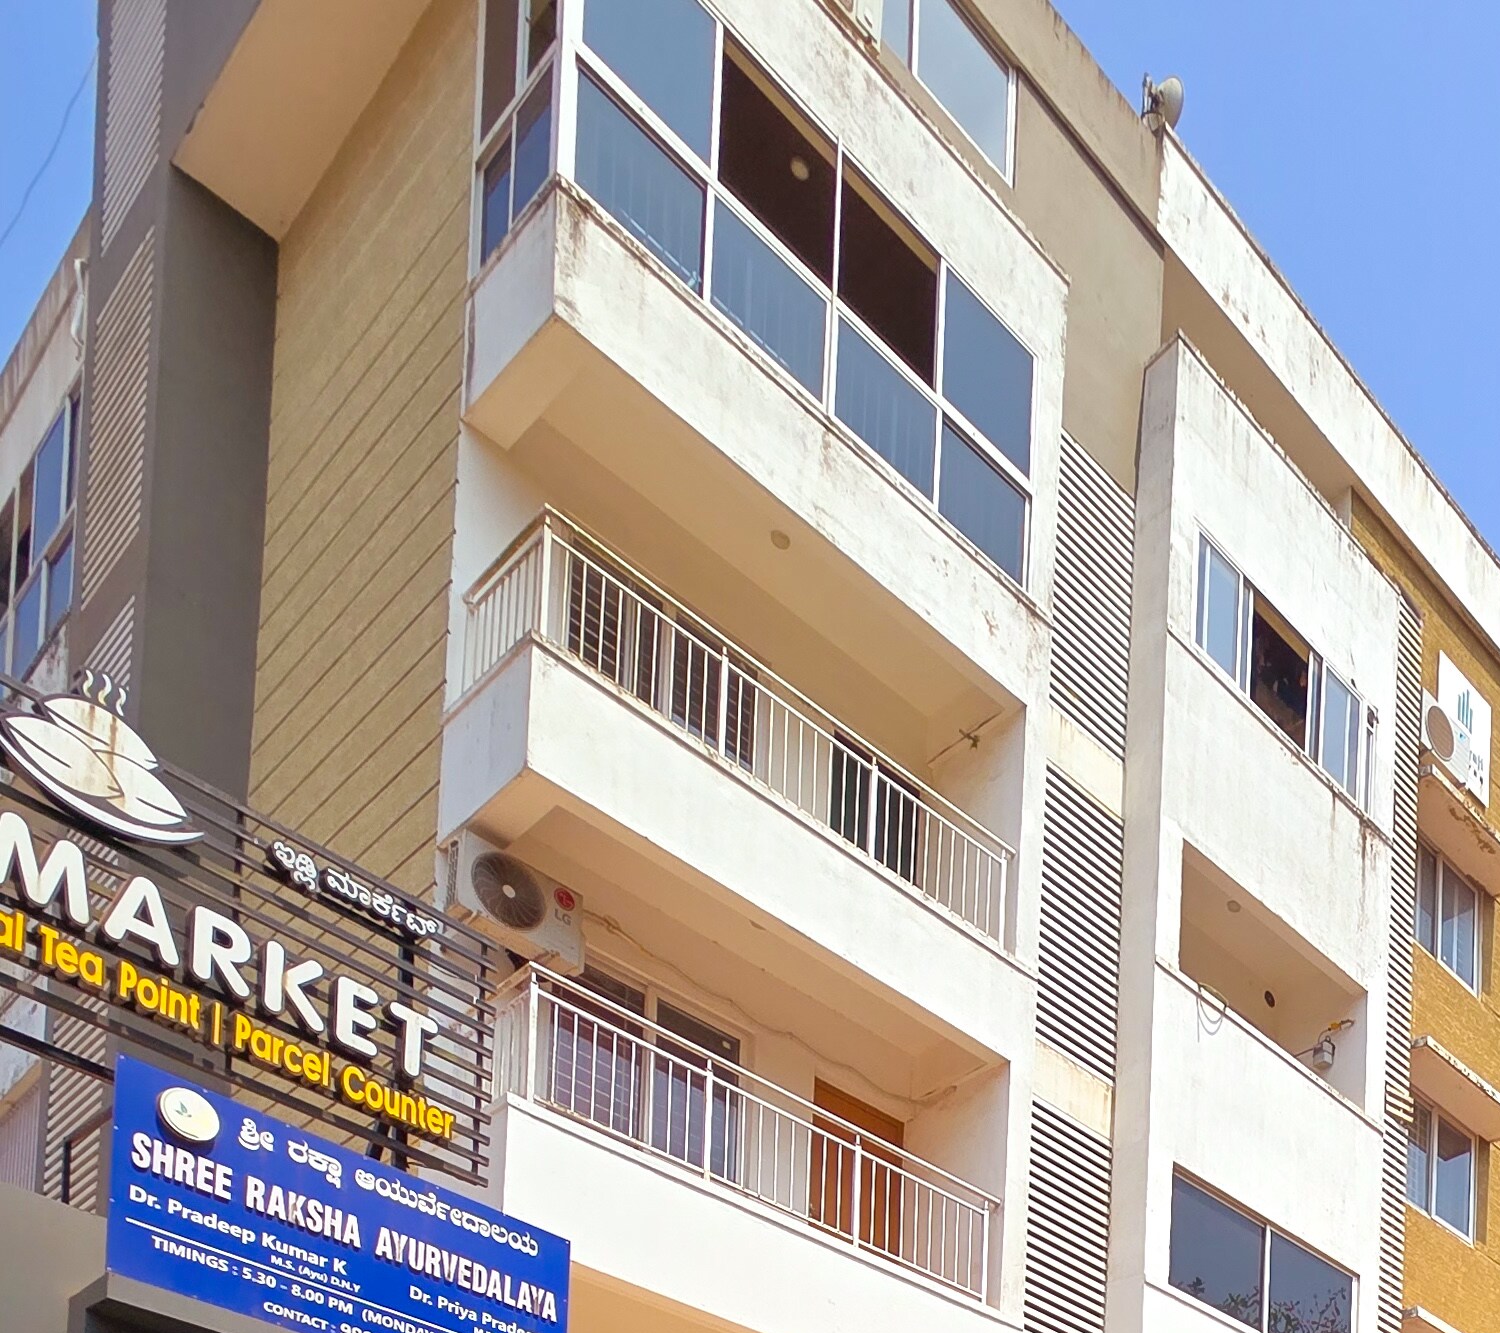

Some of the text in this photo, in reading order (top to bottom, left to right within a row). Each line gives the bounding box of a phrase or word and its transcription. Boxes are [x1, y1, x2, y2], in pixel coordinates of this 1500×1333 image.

[0, 811, 440, 1078] MARKET
[554, 908, 572, 926] LG
[39, 924, 104, 987] Tea
[119, 960, 200, 1029] Point
[234, 1012, 330, 1087] Parcel
[342, 1065, 456, 1139] Counter
[238, 1118, 275, 1151] ಶ್ರೀ
[129, 1184, 347, 1275] Dr. Pradeep Kumar K
[131, 1132, 558, 1323] SHREE RAKSHA AYURVEDALAYA
[151, 1235, 229, 1272] TIMINGS
[241, 1265, 277, 1288] 5.30
[291, 1284, 324, 1305] 8.00
[328, 1297, 353, 1316] PM
[409, 1285, 433, 1306] Dr.
[437, 1294, 478, 1322] Priya
[263, 1300, 329, 1333] CONTACT
